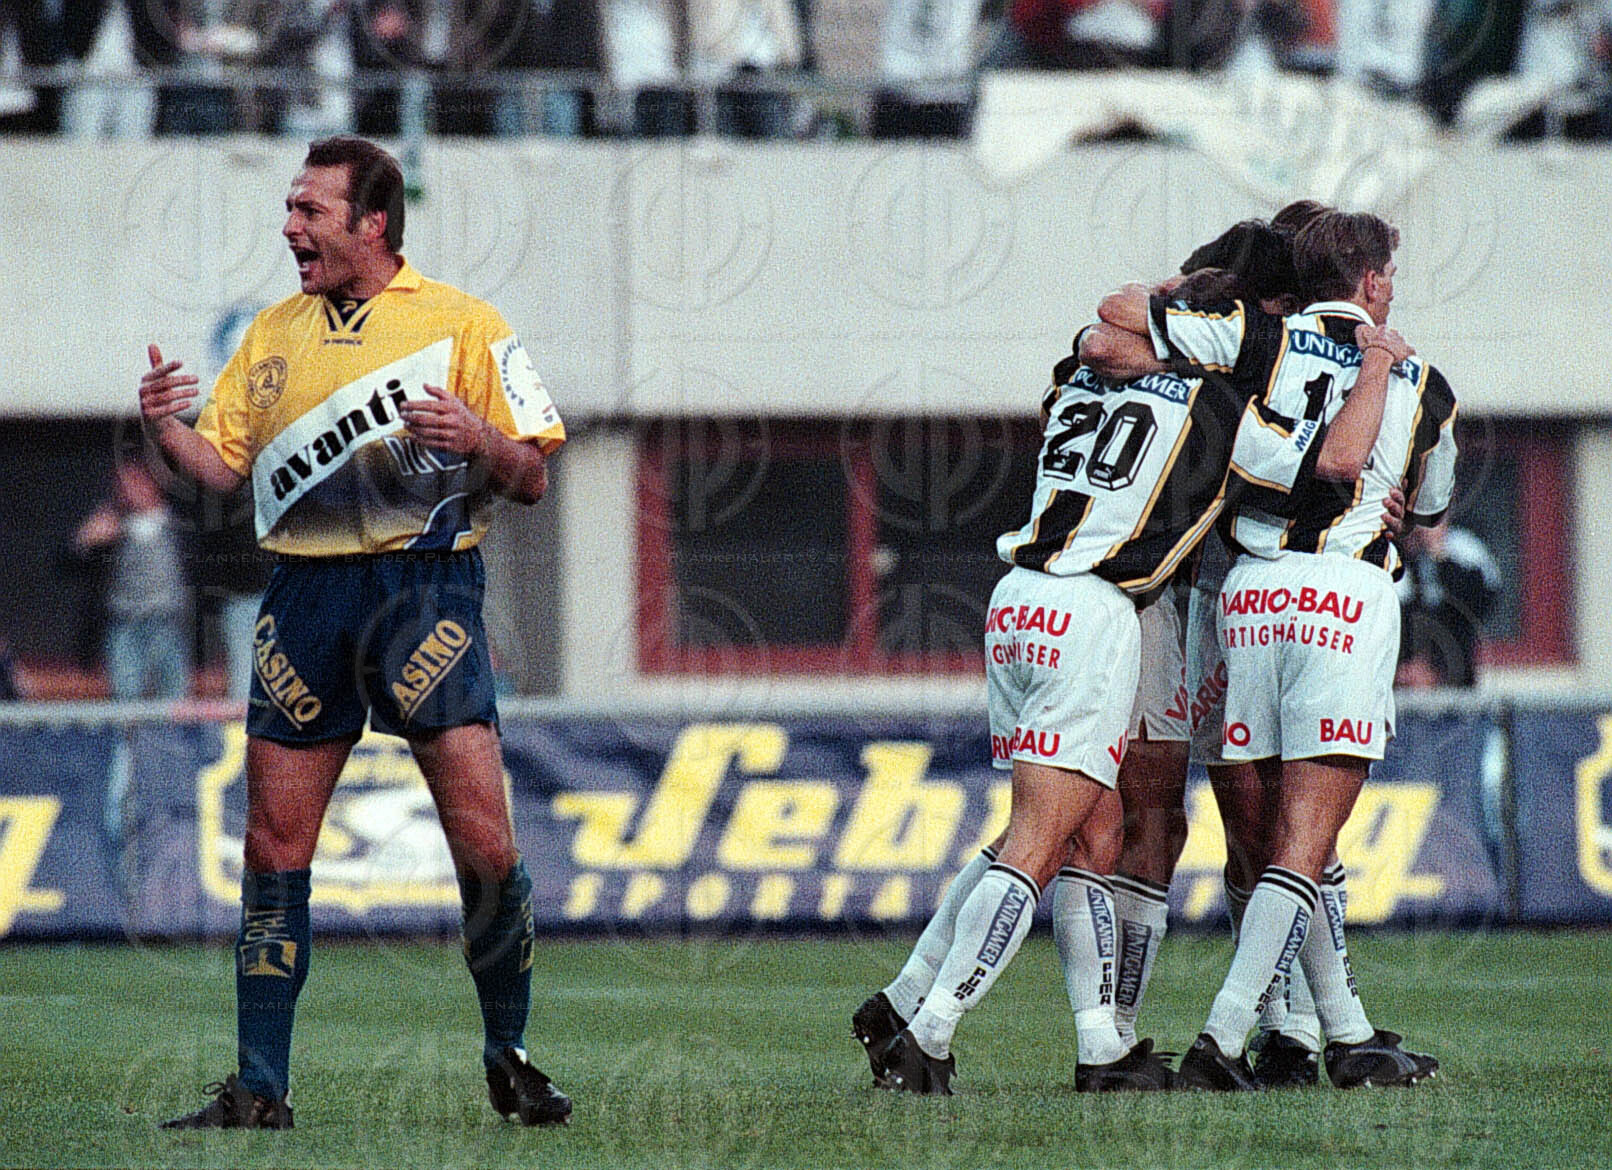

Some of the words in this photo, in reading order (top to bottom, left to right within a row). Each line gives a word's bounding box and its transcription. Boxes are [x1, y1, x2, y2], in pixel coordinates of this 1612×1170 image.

[269, 378, 409, 501] avanti
[1042, 401, 1158, 491] 20
[1223, 616, 1354, 655] RTIGHÄUSER
[253, 614, 323, 723] CASINO
[391, 618, 468, 716] ASINO
[1012, 726, 1061, 757] BAU
[1319, 717, 1373, 746] BAU
[1089, 887, 1113, 958] UNTIGAMER
[953, 966, 987, 1001] PUMA
[1099, 962, 1113, 1006] PUMA
[1254, 973, 1282, 1014] PUMA
